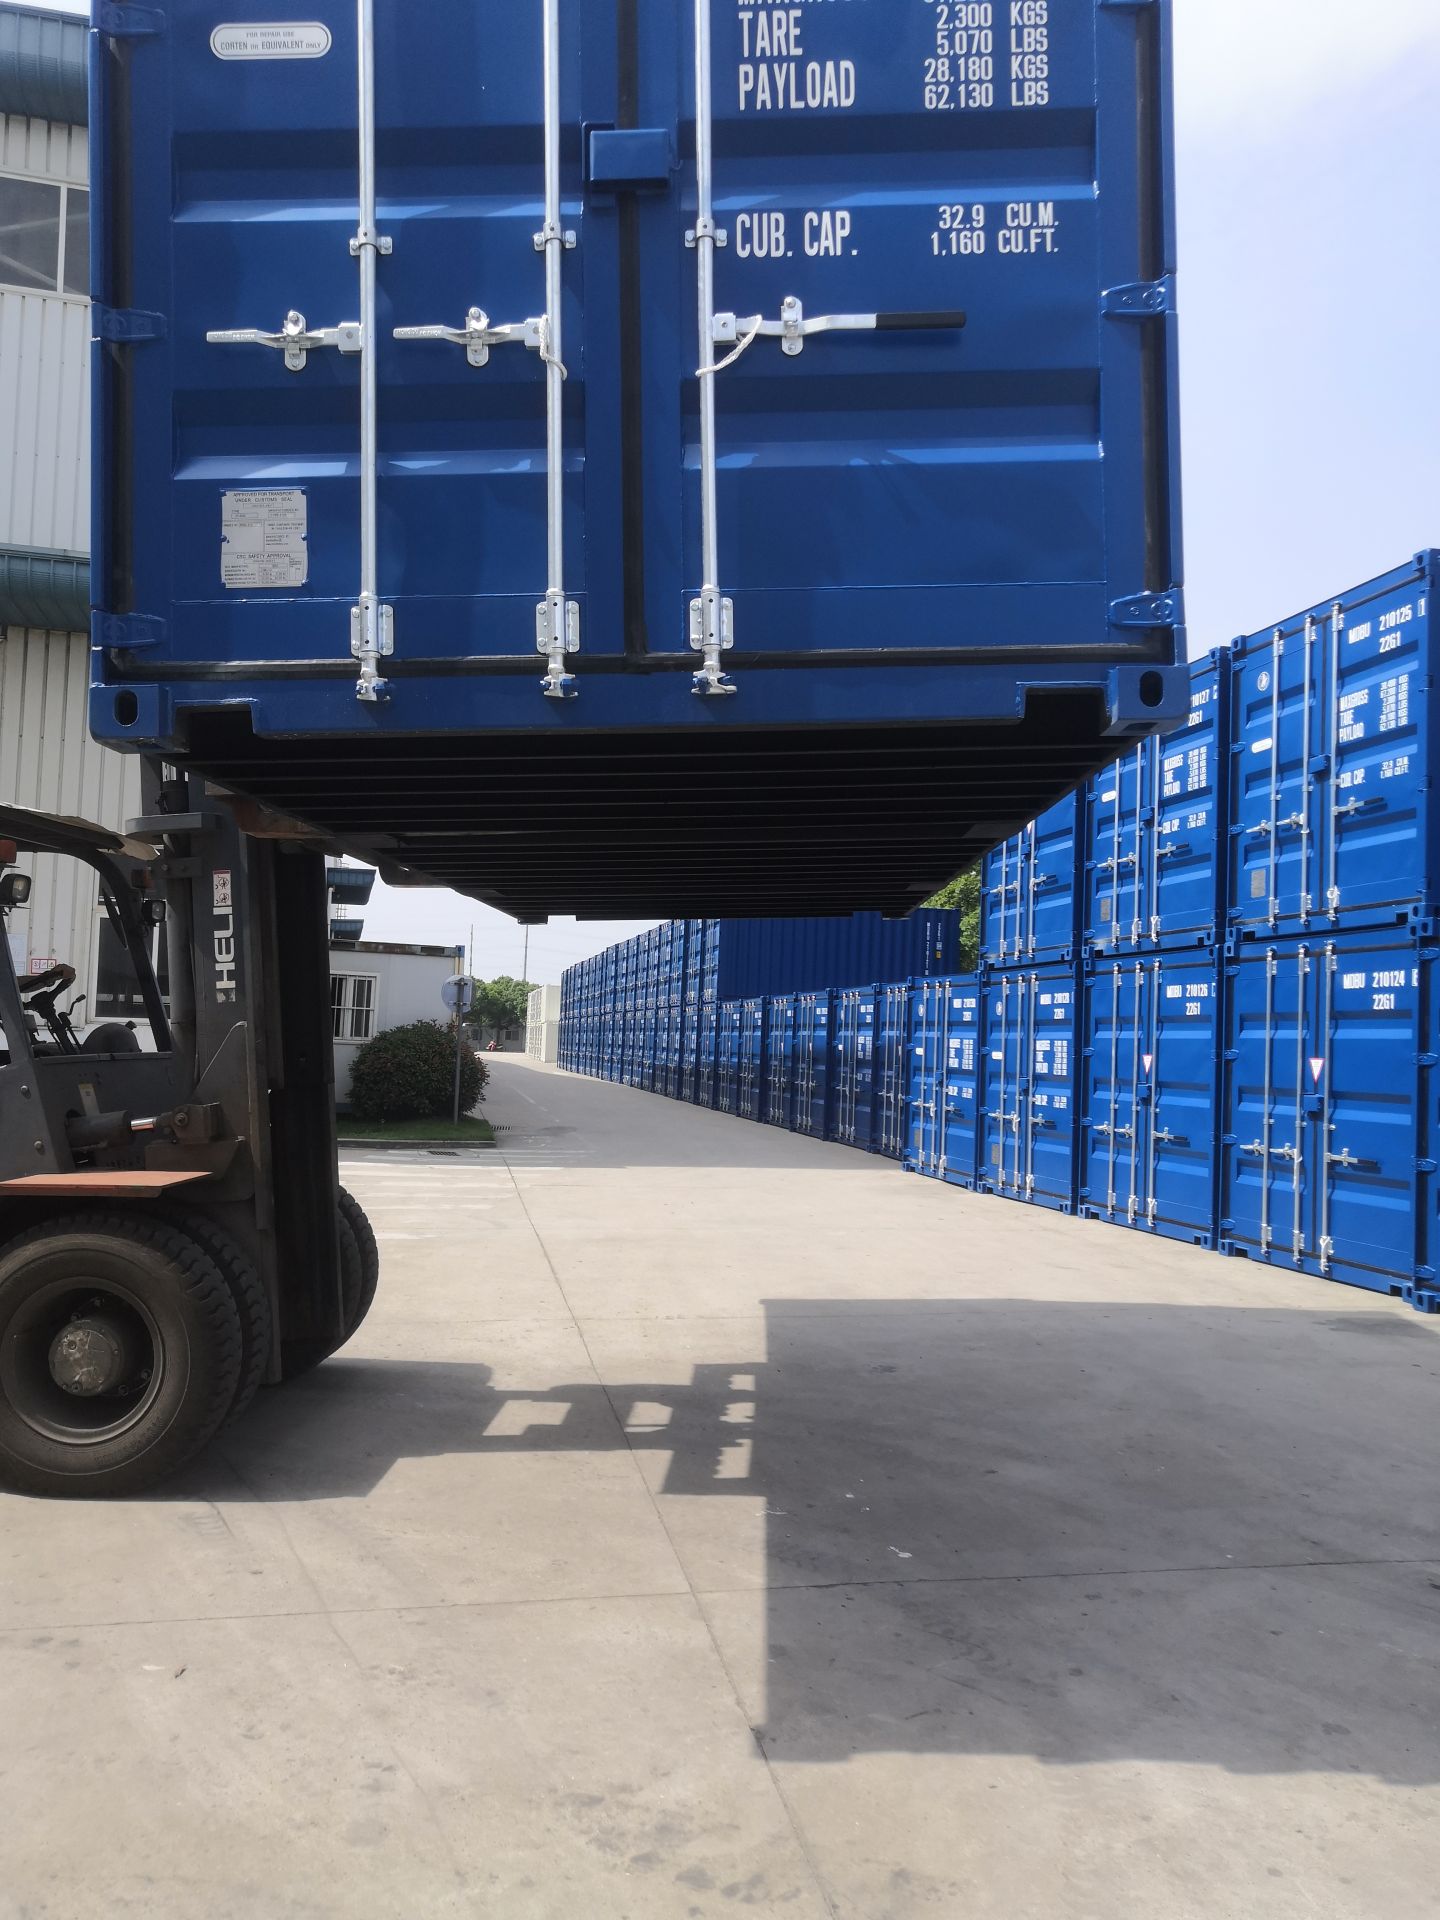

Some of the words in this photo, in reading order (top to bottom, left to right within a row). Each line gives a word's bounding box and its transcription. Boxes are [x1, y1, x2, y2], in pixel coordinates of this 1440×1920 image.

[936, 3, 992, 29] 2,300
[1010, 1, 1048, 26] KGS
[261, 40, 304, 50] EQUIVALENT
[738, 9, 803, 58] TARE
[937, 29, 993, 56] 5,070
[1010, 27, 1048, 53] LBS
[924, 56, 993, 83] 28,180
[1010, 54, 1049, 79] KGS
[738, 59, 856, 111] PAYLOAD
[924, 82, 994, 110] 62,130
[1011, 80, 1049, 106] LBS
[938, 204, 986, 229] 32.9
[1005, 202, 1059, 228] CU.M.
[736, 212, 793, 258] CUB.
[803, 210, 858, 257] CAP.
[930, 230, 986, 256] 1,160
[997, 228, 1059, 254] CU.FT.
[1379, 604, 1412, 631] 210125
[213, 906, 236, 989] HELI
[1372, 970, 1406, 988] 210124
